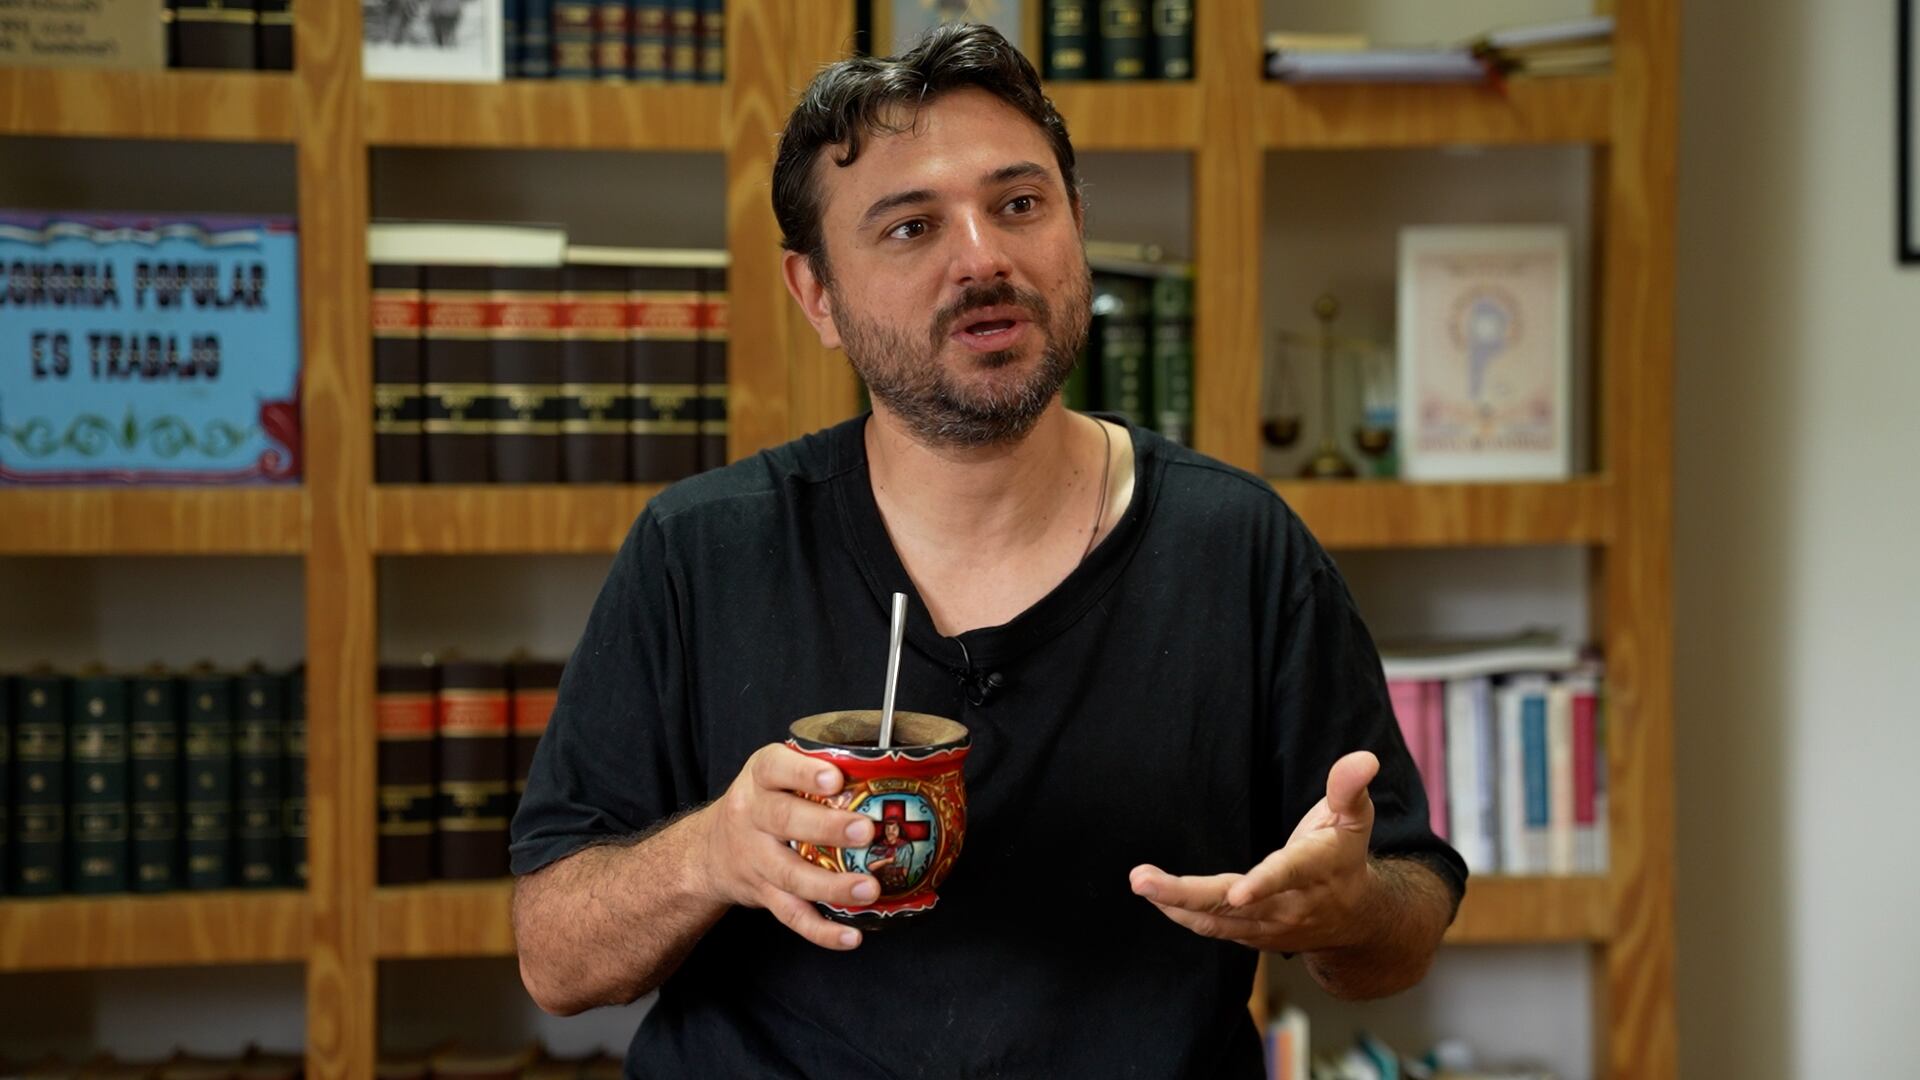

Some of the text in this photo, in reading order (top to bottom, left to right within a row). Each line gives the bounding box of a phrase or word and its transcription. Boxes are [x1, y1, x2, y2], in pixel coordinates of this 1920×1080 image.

[135, 260, 267, 308] POPULAR
[31, 331, 221, 380] ES TRABAJO
